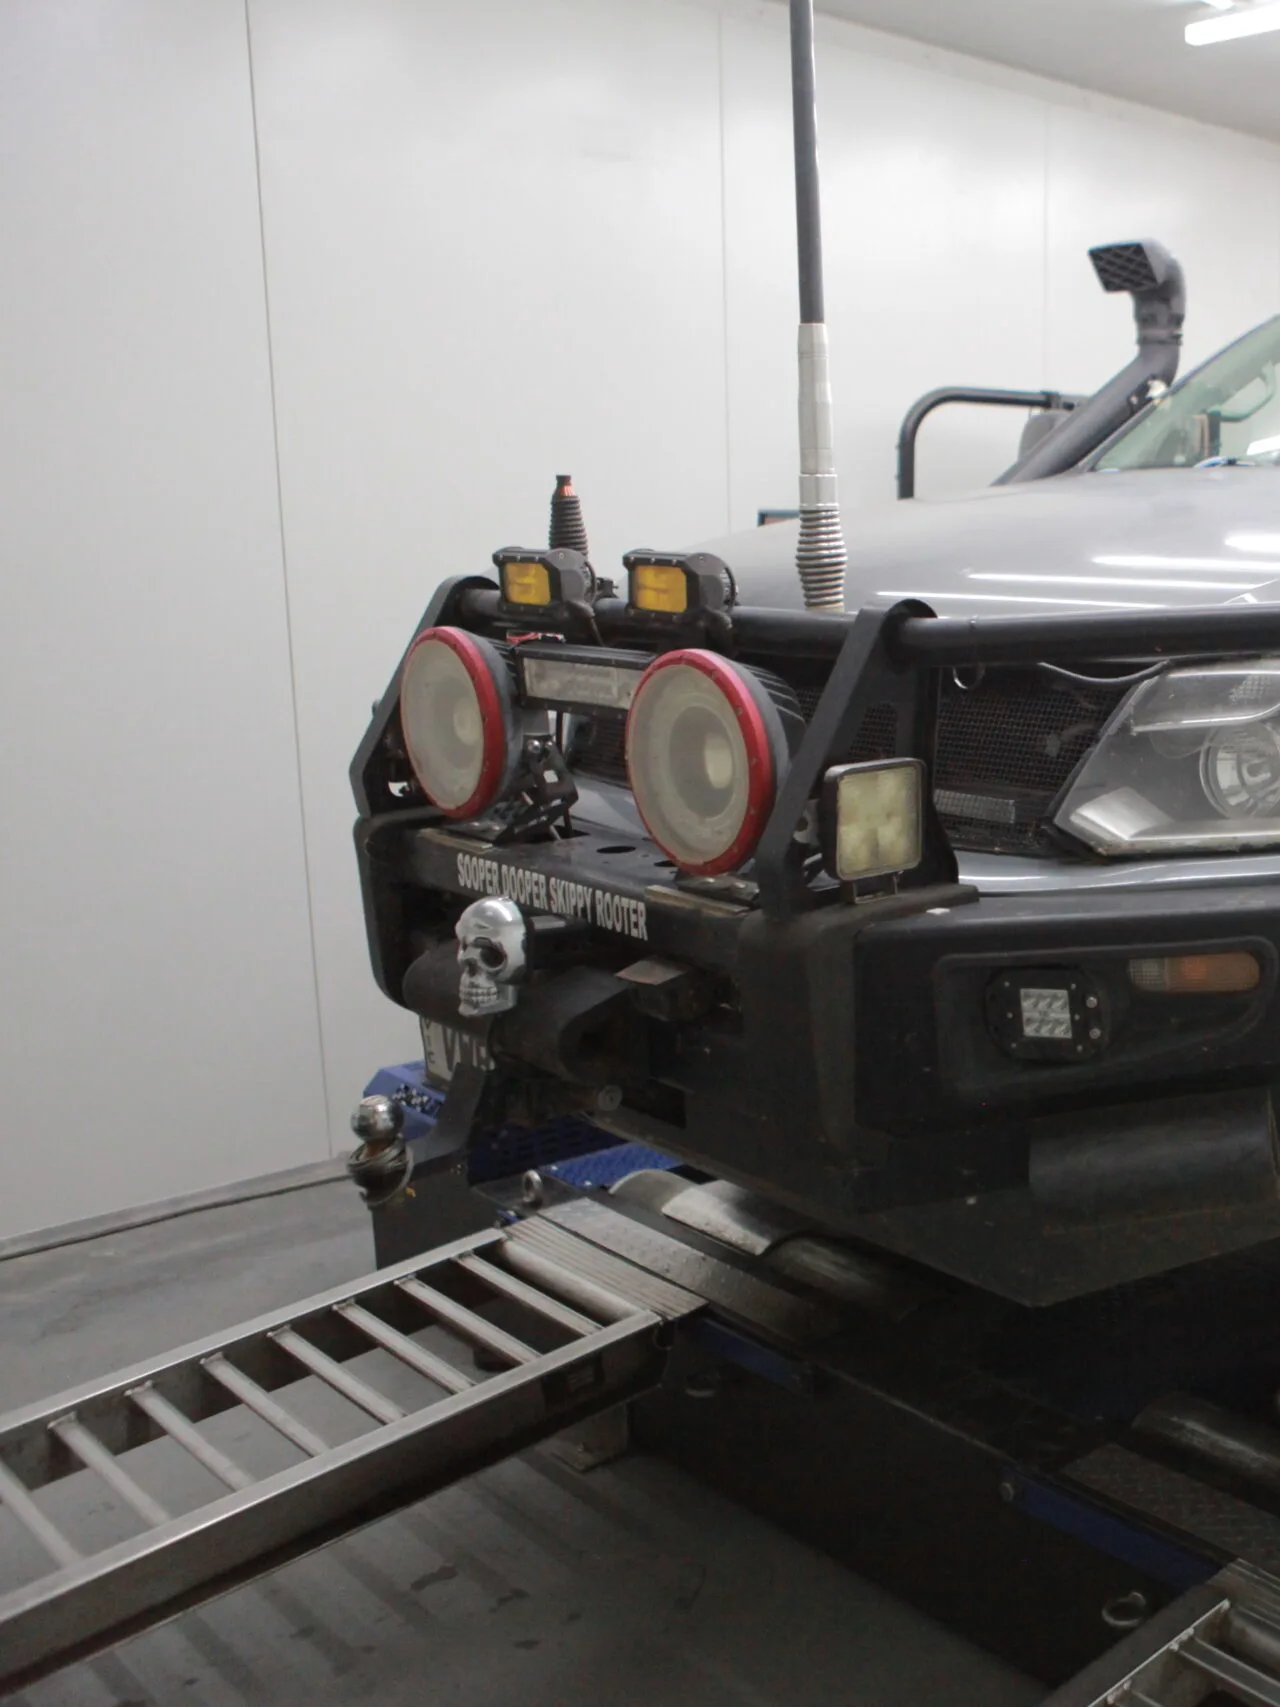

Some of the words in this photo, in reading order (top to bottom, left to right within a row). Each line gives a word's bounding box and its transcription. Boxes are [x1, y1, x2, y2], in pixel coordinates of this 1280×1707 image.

[457, 852, 500, 895] SOOPER
[501, 864, 549, 910] DOOPER
[550, 876, 593, 924] SKIPPY
[595, 890, 648, 941] ROOTER
